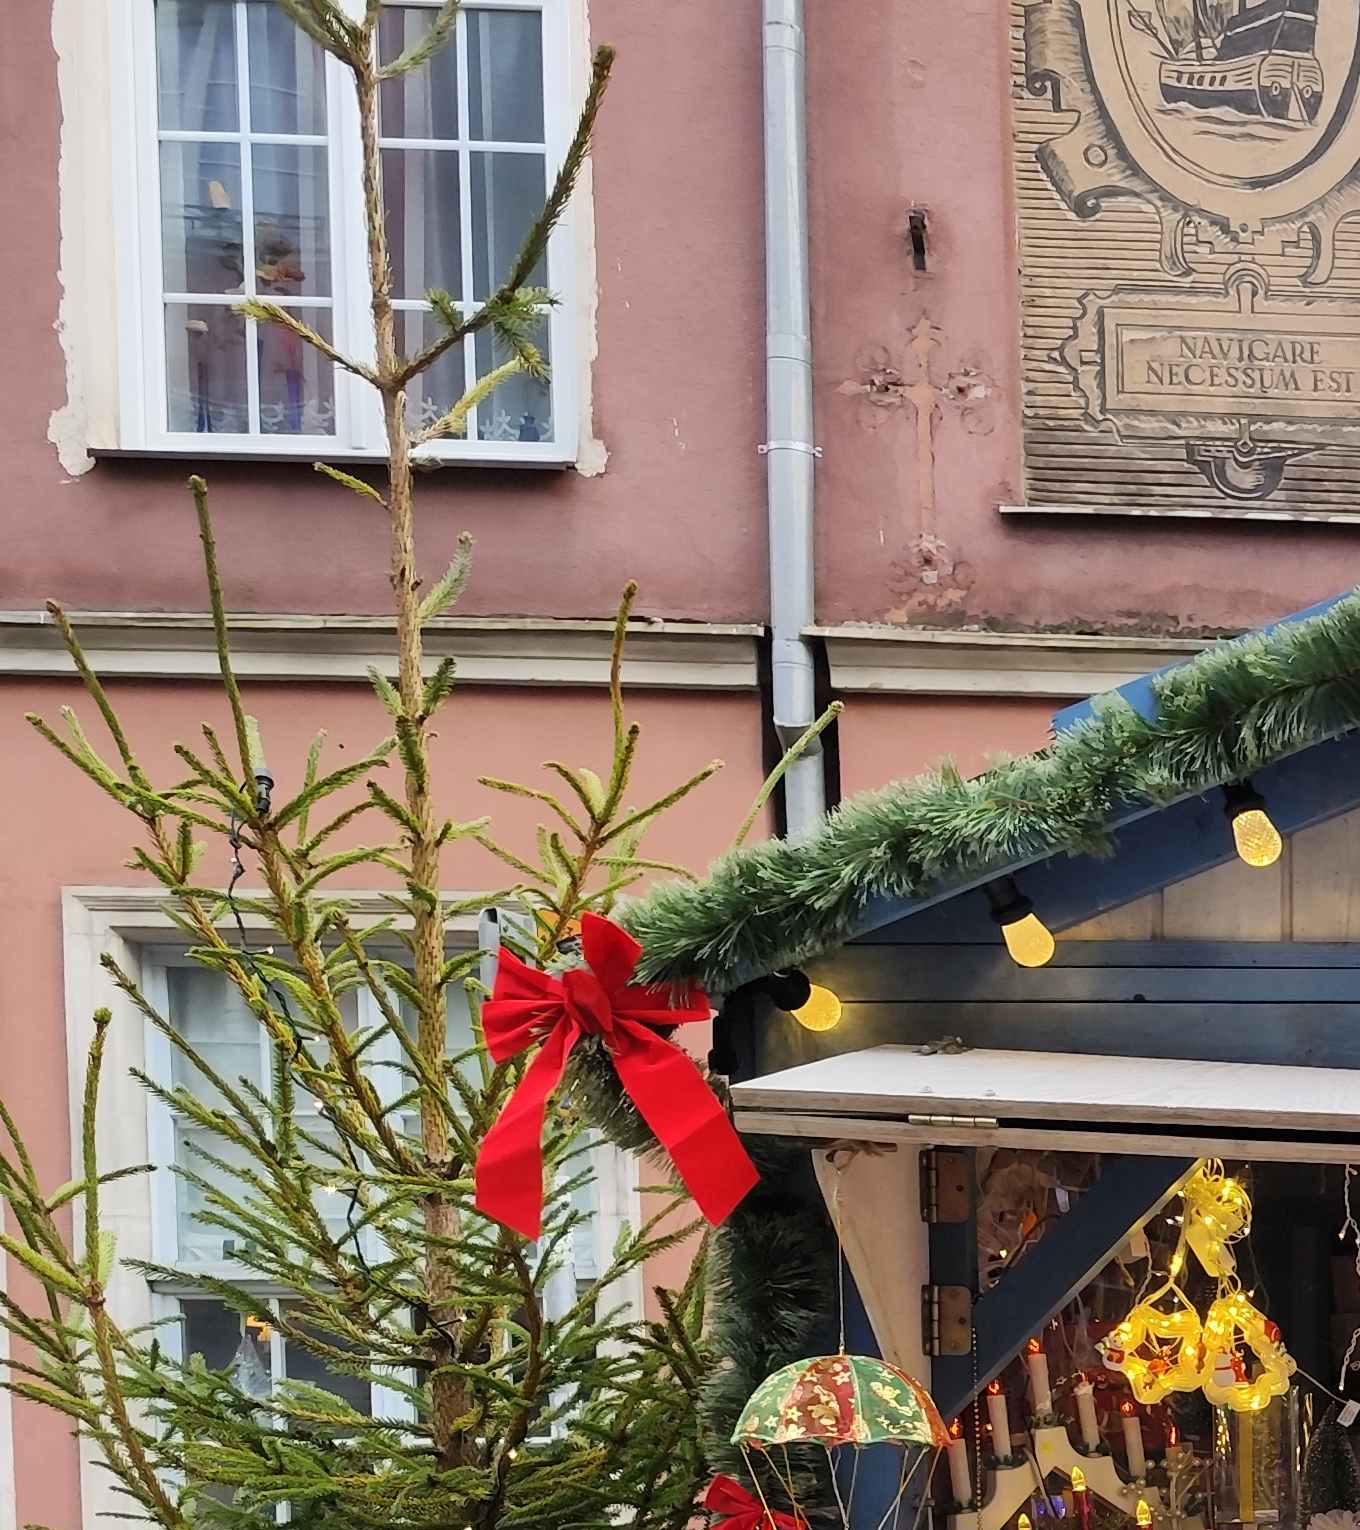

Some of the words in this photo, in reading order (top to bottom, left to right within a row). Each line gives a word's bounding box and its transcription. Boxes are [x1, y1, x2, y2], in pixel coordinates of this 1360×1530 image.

[1178, 335, 1324, 366] NAVIGARE
[1144, 360, 1303, 393] NECESSUM
[1311, 369, 1356, 393] EST
